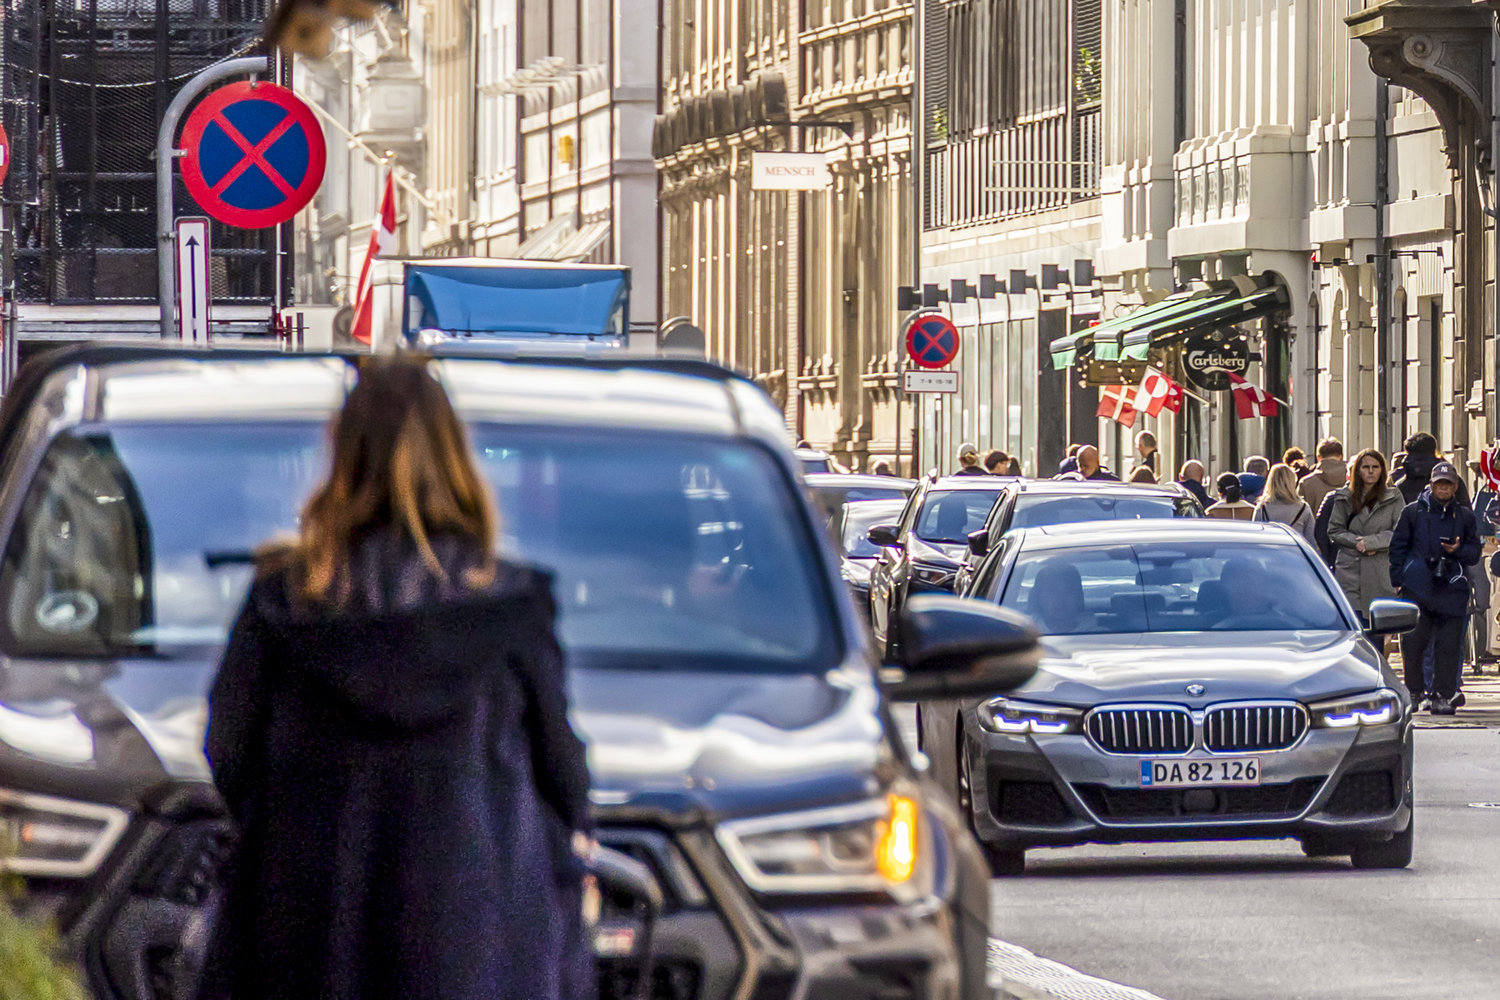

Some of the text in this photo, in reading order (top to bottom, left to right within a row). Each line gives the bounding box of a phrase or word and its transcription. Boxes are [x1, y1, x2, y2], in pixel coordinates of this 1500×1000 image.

[765, 166, 815, 176] MENSCH
[1188, 350, 1246, 371] Carlsberg
[1154, 761, 1257, 782] DA 82 126
